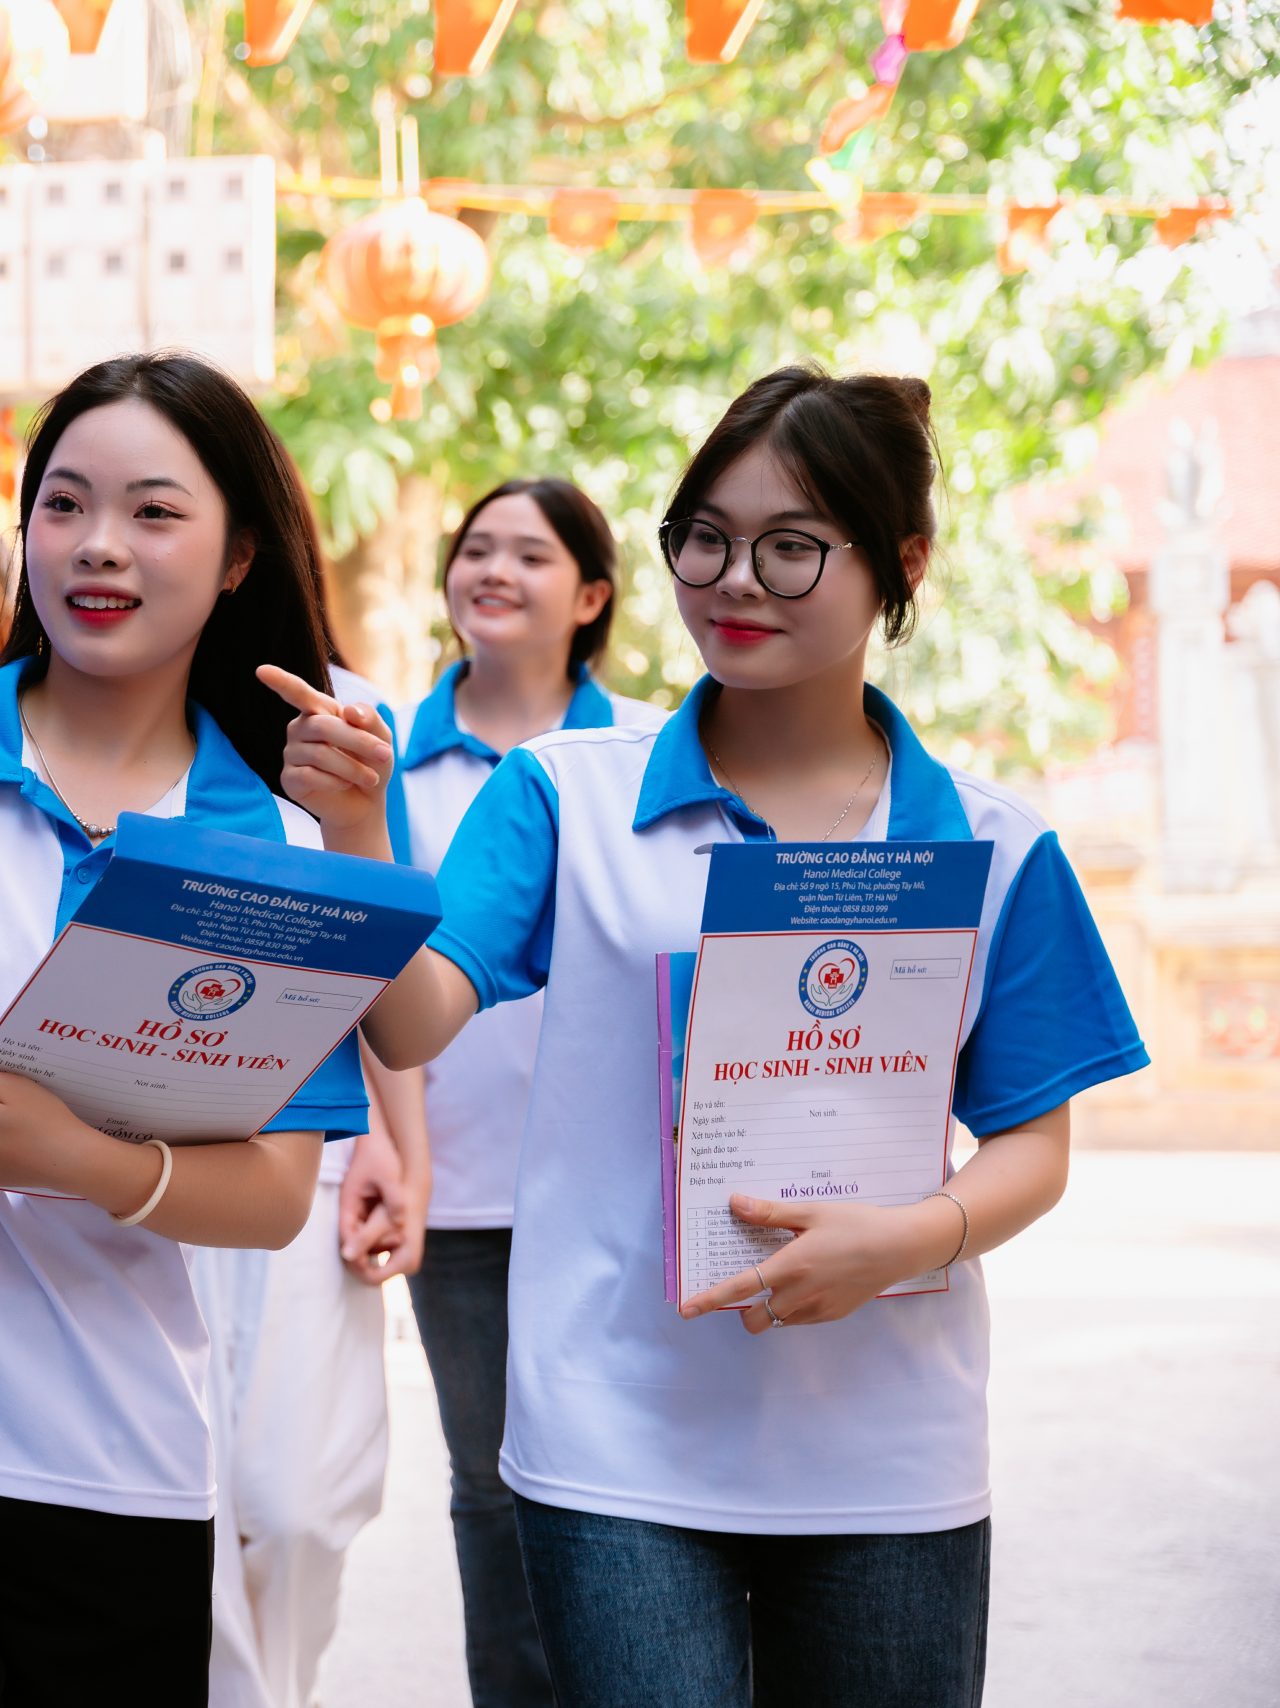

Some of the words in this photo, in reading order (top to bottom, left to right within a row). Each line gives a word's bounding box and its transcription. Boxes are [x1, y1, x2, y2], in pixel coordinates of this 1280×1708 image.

[776, 851, 824, 864] TRƯỜNG
[825, 852, 848, 864] CAO
[851, 848, 885, 864] ĐẲNG
[886, 853, 894, 864] Y
[895, 850, 912, 864] HÀ
[914, 850, 934, 866] NỘI
[803, 869, 830, 879] Hanoi
[831, 868, 867, 879] Medical
[868, 869, 902, 881] College
[774, 883, 786, 892] Địa
[800, 882, 809, 891] Số
[831, 883, 841, 891] 15,
[842, 882, 856, 890] Phú
[873, 882, 901, 892] phường
[901, 883, 913, 892] Tây
[181, 879, 239, 900] TRƯỜNG
[240, 891, 269, 905] CAO
[270, 896, 310, 913] ĐẲNG
[310, 905, 321, 915] Y
[320, 905, 340, 918] HÀ
[341, 911, 368, 925] NỘI
[799, 894, 817, 903] quận
[818, 894, 834, 902] Nam
[875, 893, 885, 901] Hà
[886, 893, 898, 902] Nội
[210, 900, 242, 914] Hanoi
[242, 905, 283, 921] Medical
[284, 914, 324, 929] College
[805, 905, 821, 914] Điện
[822, 905, 842, 914] thoại:
[842, 905, 860, 913] 0858
[861, 905, 874, 913] 830
[875, 905, 888, 913] 999
[791, 916, 820, 925] Website:
[820, 916, 897, 926] caodangyhanoi.edu.vn
[220, 923, 239, 933] Nam
[200, 929, 220, 940] Điện
[244, 937, 265, 947] 0858
[266, 941, 282, 950] 830
[282, 944, 297, 952] 999
[180, 933, 216, 949] Website:
[216, 941, 304, 963] caodangyhanoi.edu.vn
[894, 966, 906, 974] Mã
[907, 965, 916, 974] hồ
[282, 992, 296, 1002] Mã
[297, 994, 308, 1002] hồ
[135, 1017, 183, 1042] HỒ
[184, 1029, 229, 1048] SƠ
[786, 1019, 823, 1051] HỒ
[828, 1025, 862, 1050] SƠ
[2, 1037, 16, 1046] Họ
[36, 1018, 95, 1044] HỌC
[96, 1034, 160, 1058] SINH
[172, 1049, 234, 1067] SINH
[236, 1053, 291, 1072] VIÊN
[714, 1062, 758, 1086] HỌC
[762, 1059, 810, 1079] SINH
[825, 1057, 873, 1076] SINH
[880, 1050, 929, 1073] VIÊN
[134, 1079, 149, 1088] Nơi
[149, 1080, 169, 1091] sinh:
[694, 1101, 704, 1111] Họ
[714, 1099, 726, 1109] tên:
[810, 1110, 822, 1118] Nơi
[823, 1109, 839, 1117] sinh:
[693, 1116, 710, 1126] Ngày
[711, 1116, 727, 1124] sinh:
[692, 1131, 704, 1140] Xét
[705, 1129, 723, 1141] tuyển
[724, 1130, 736, 1138] vào
[691, 1147, 712, 1156] Ngành
[713, 1146, 726, 1154] đào
[727, 1146, 740, 1155] tạo:
[690, 1162, 701, 1170] Hộ
[702, 1160, 718, 1169] khẩu
[719, 1160, 743, 1170] thường
[811, 1170, 833, 1179] Email:
[690, 1178, 706, 1186] Điện
[707, 1177, 727, 1185] thoại:
[780, 1183, 798, 1198] HỒ
[800, 1185, 815, 1198] SƠ
[817, 1181, 843, 1196] GỒM
[845, 1181, 859, 1195] CÓ
